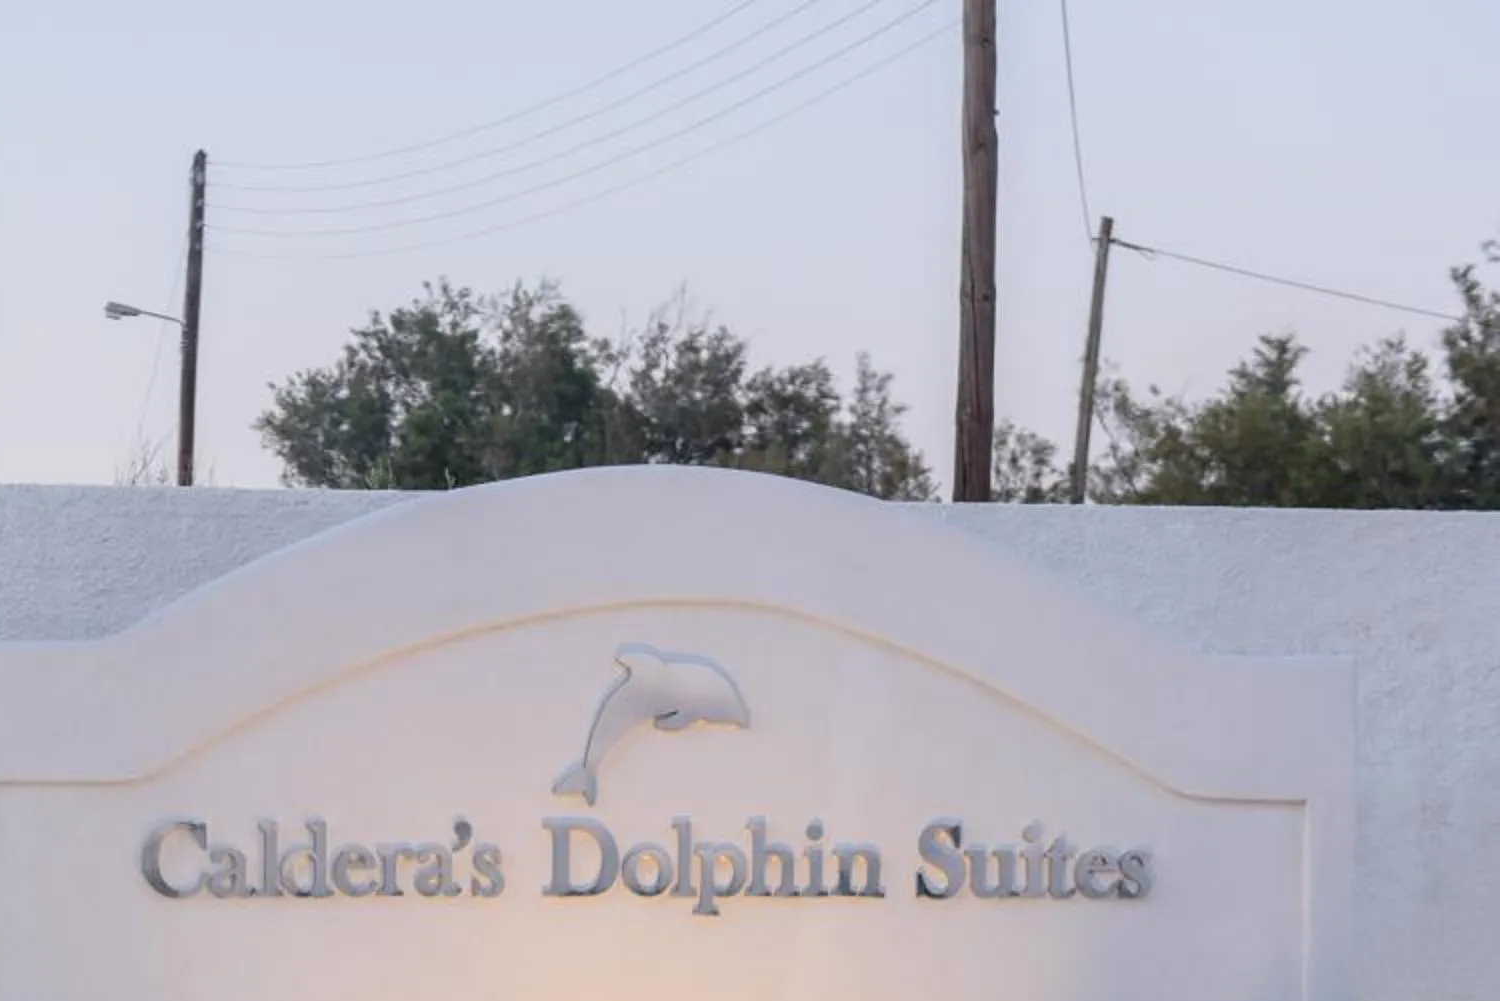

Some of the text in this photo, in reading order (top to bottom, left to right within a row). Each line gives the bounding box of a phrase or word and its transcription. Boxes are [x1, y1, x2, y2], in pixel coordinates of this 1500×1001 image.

[140, 816, 1153, 916] Caldera's Dolphin Suites
